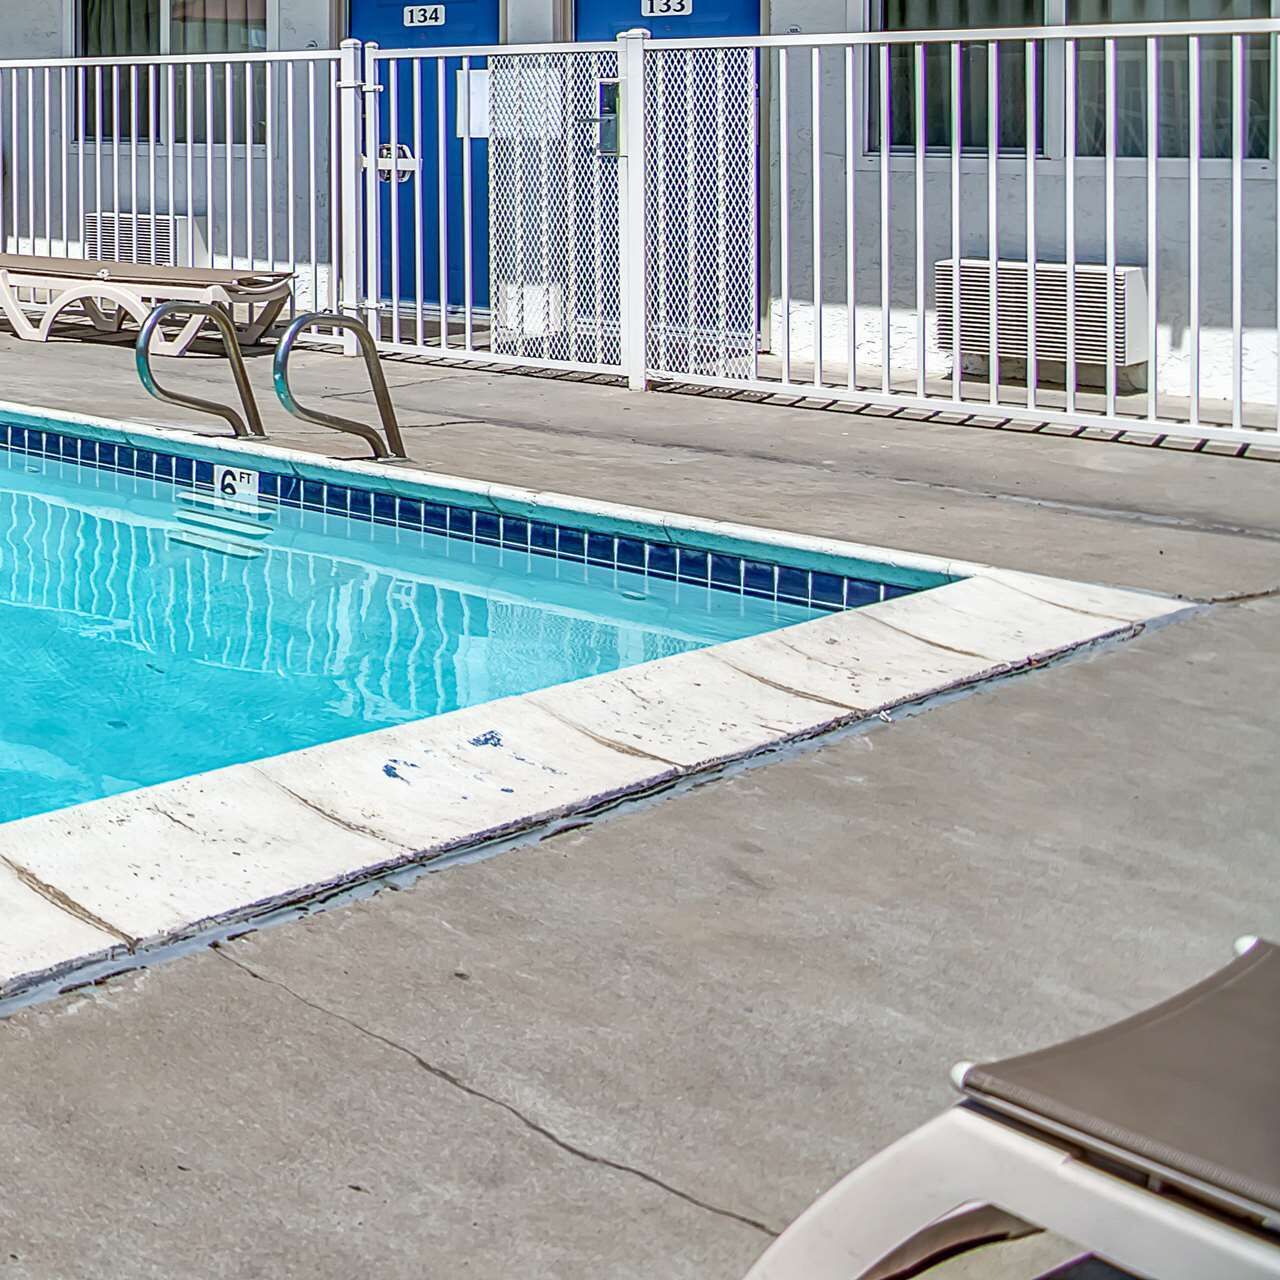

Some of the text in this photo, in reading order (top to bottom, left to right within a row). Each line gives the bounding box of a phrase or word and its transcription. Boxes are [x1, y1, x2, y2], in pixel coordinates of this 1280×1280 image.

[408, 8, 440, 23] 134
[221, 469, 252, 496] 6 FT
